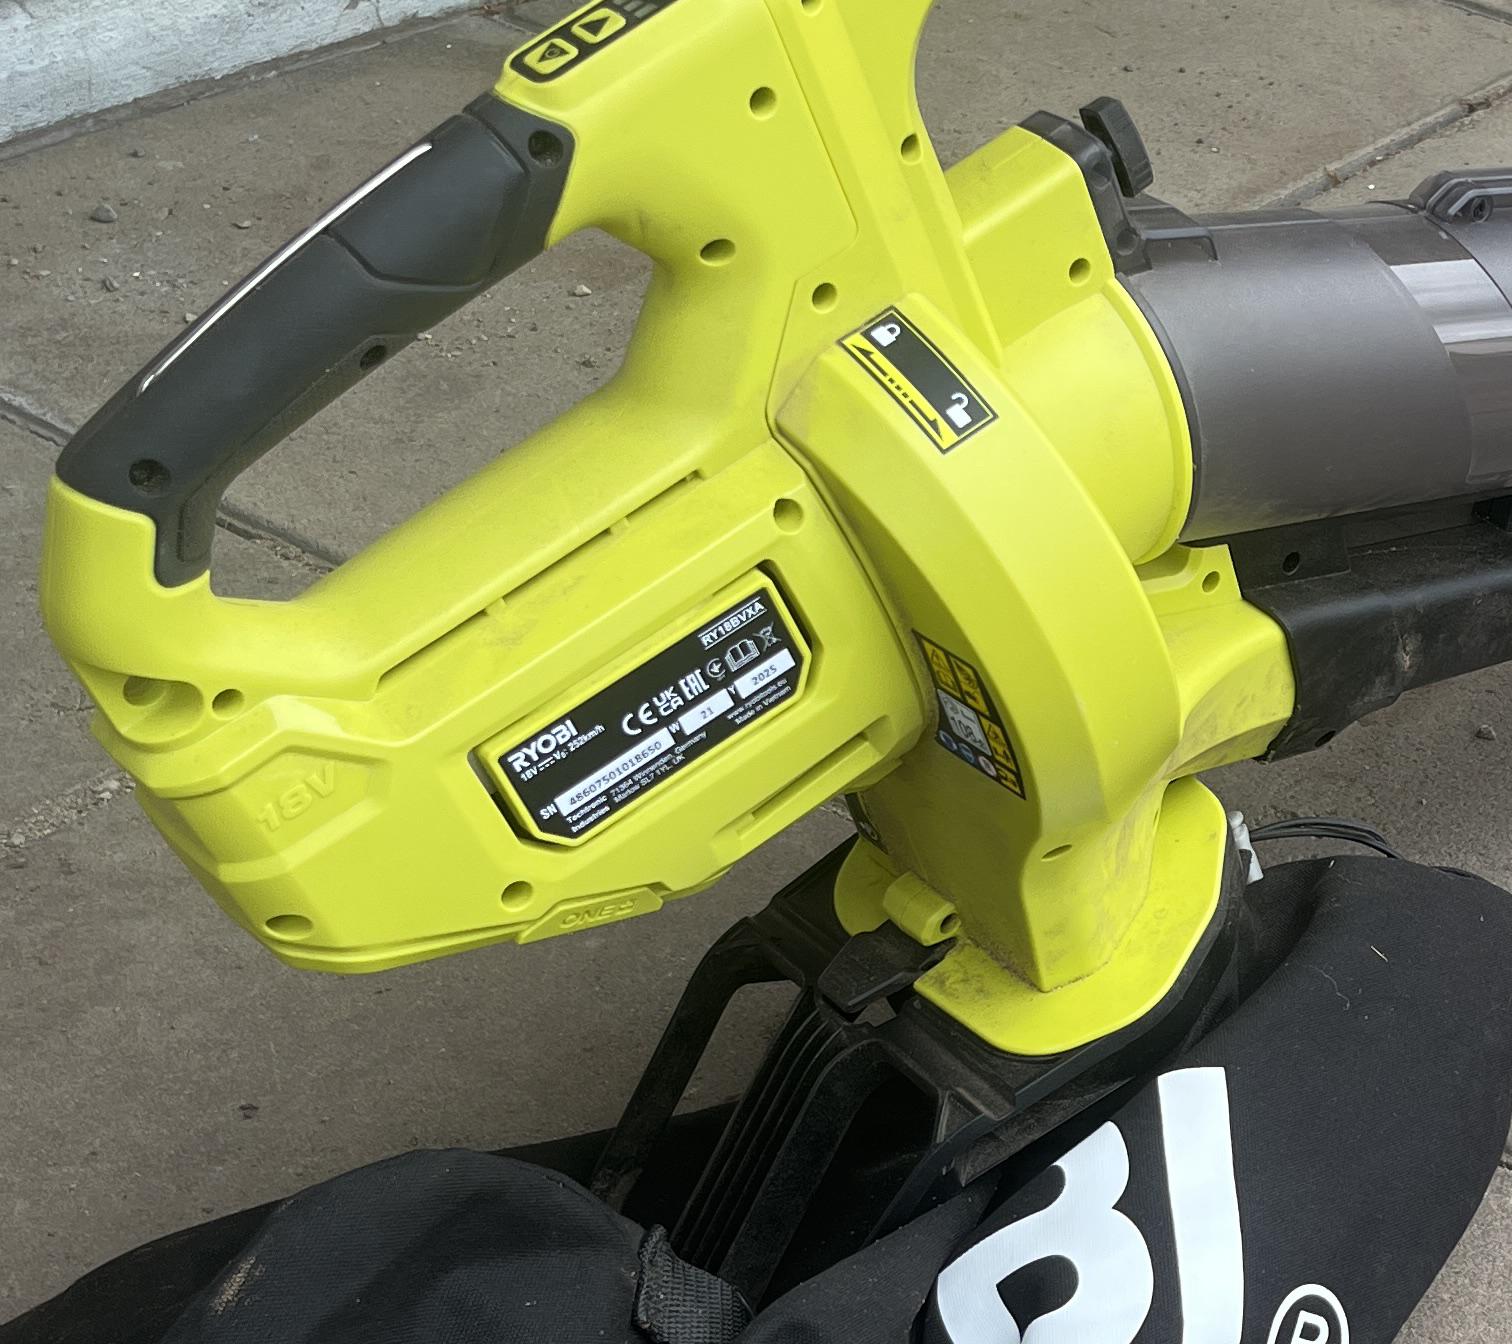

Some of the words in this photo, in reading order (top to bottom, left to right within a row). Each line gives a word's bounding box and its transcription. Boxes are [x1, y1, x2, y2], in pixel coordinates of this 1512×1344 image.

[701, 601, 766, 647] RY18BVXA
[507, 719, 579, 773] RYOBI
[539, 804, 558, 820] SN
[668, 720, 681, 734] W
[700, 706, 715, 720] 21
[751, 664, 778, 686] 2025
[255, 761, 335, 832] 18V
